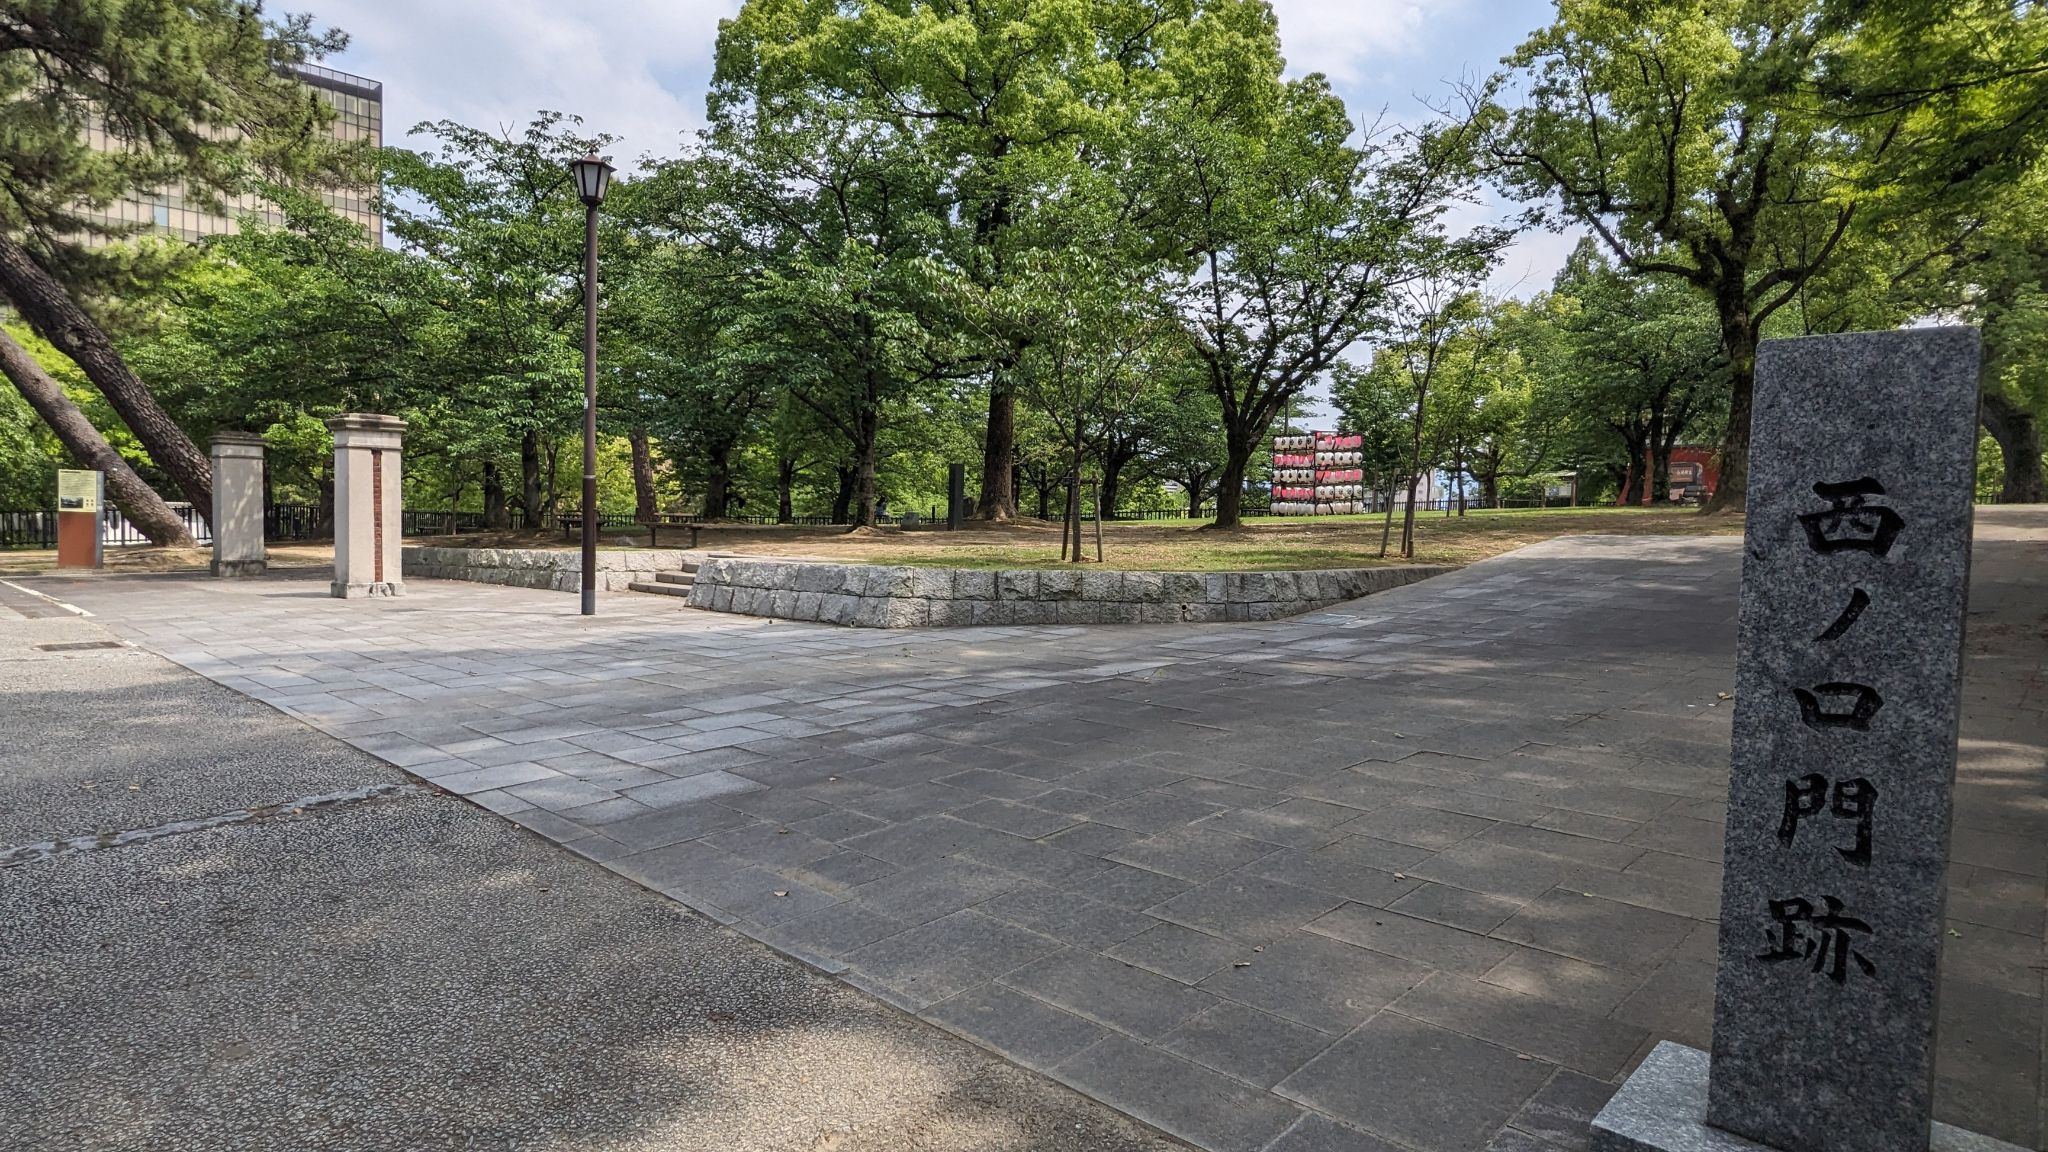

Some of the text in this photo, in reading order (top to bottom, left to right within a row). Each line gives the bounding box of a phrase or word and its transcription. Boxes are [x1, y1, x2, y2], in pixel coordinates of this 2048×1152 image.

[1755, 475, 1907, 986] 西ノ口門跡
